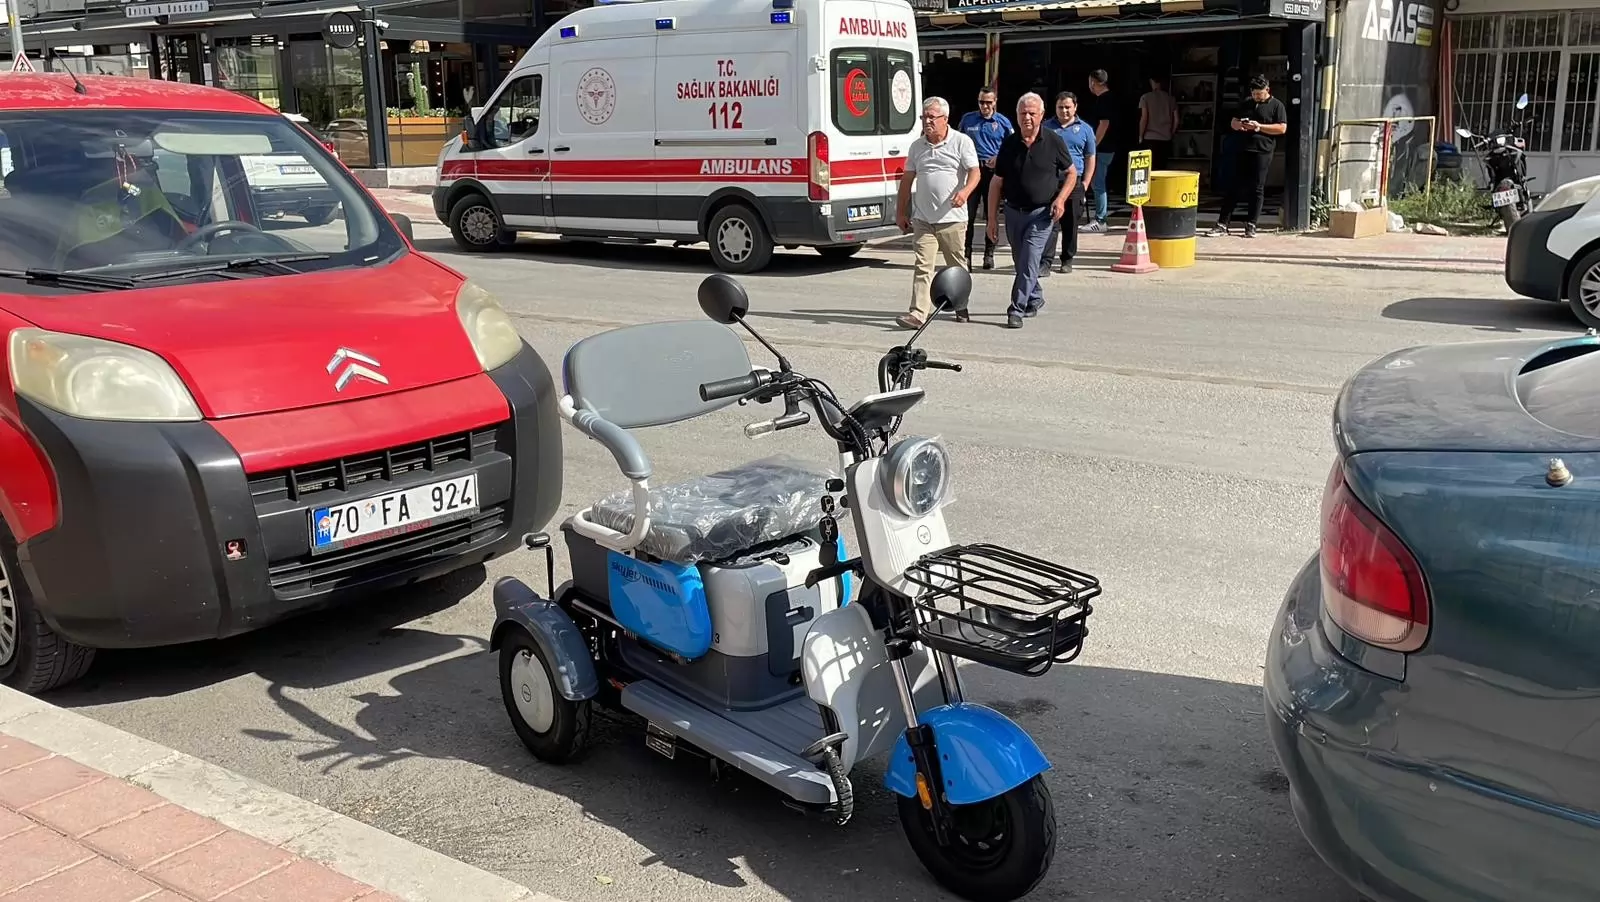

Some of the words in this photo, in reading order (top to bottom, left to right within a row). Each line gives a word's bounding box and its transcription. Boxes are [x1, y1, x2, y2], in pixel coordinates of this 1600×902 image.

[839, 17, 908, 38] AMBULANS
[1361, 0, 1418, 44] ARAS
[717, 60, 737, 76] T.C.
[677, 79, 716, 99] SAĞLIK
[719, 75, 779, 98] BAKANLIĞI
[708, 101, 743, 129] 112
[700, 158, 793, 176] AMBULANS
[1130, 157, 1149, 169] ARAS
[1180, 192, 1196, 203] OTO
[317, 528, 330, 538] TR
[330, 506, 359, 538] 70
[381, 494, 410, 525] FA
[431, 480, 472, 513] 924
